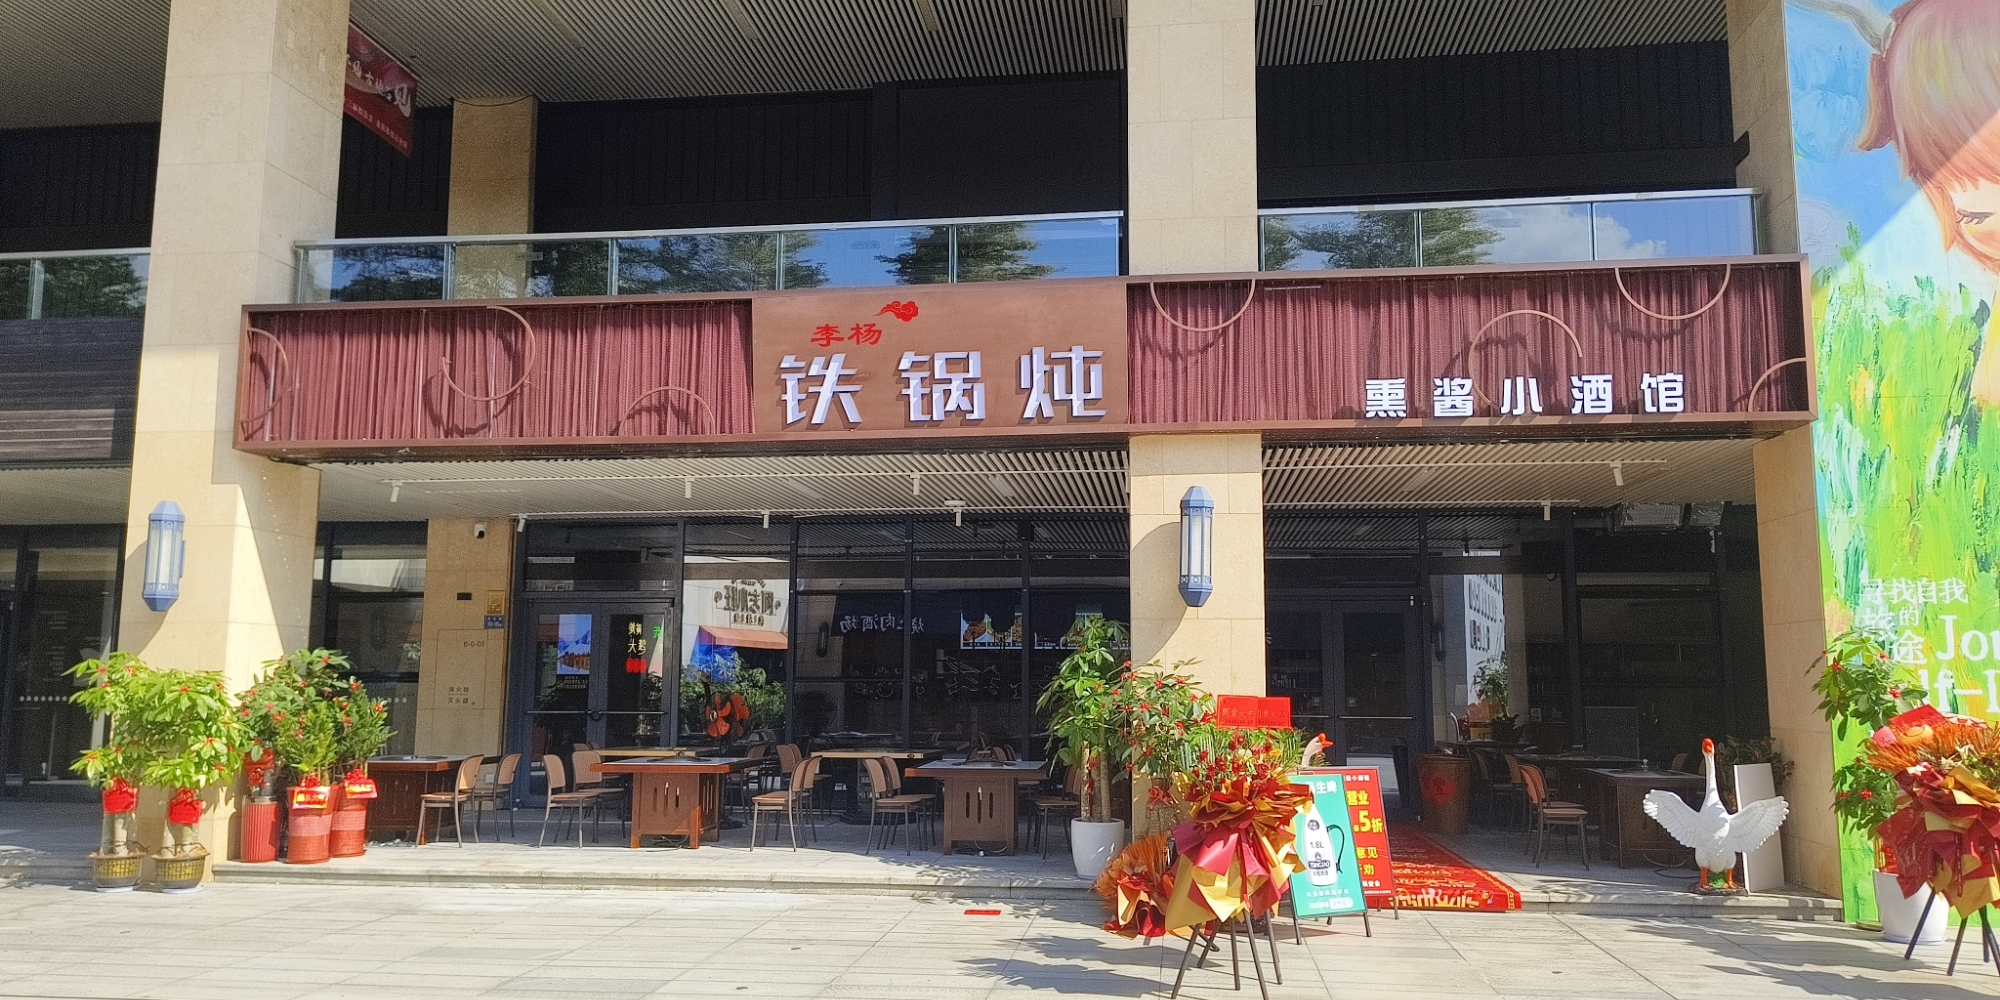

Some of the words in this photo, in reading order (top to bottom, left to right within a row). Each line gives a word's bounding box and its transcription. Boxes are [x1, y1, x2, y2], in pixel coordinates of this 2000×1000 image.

[810, 322, 883, 348] 李杨
[779, 345, 1108, 426] 铁锅炖
[1364, 371, 1686, 419] 熏酱小酒馆
[1860, 576, 1969, 605] 寻找自我
[1346, 790, 1370, 806] 营业
